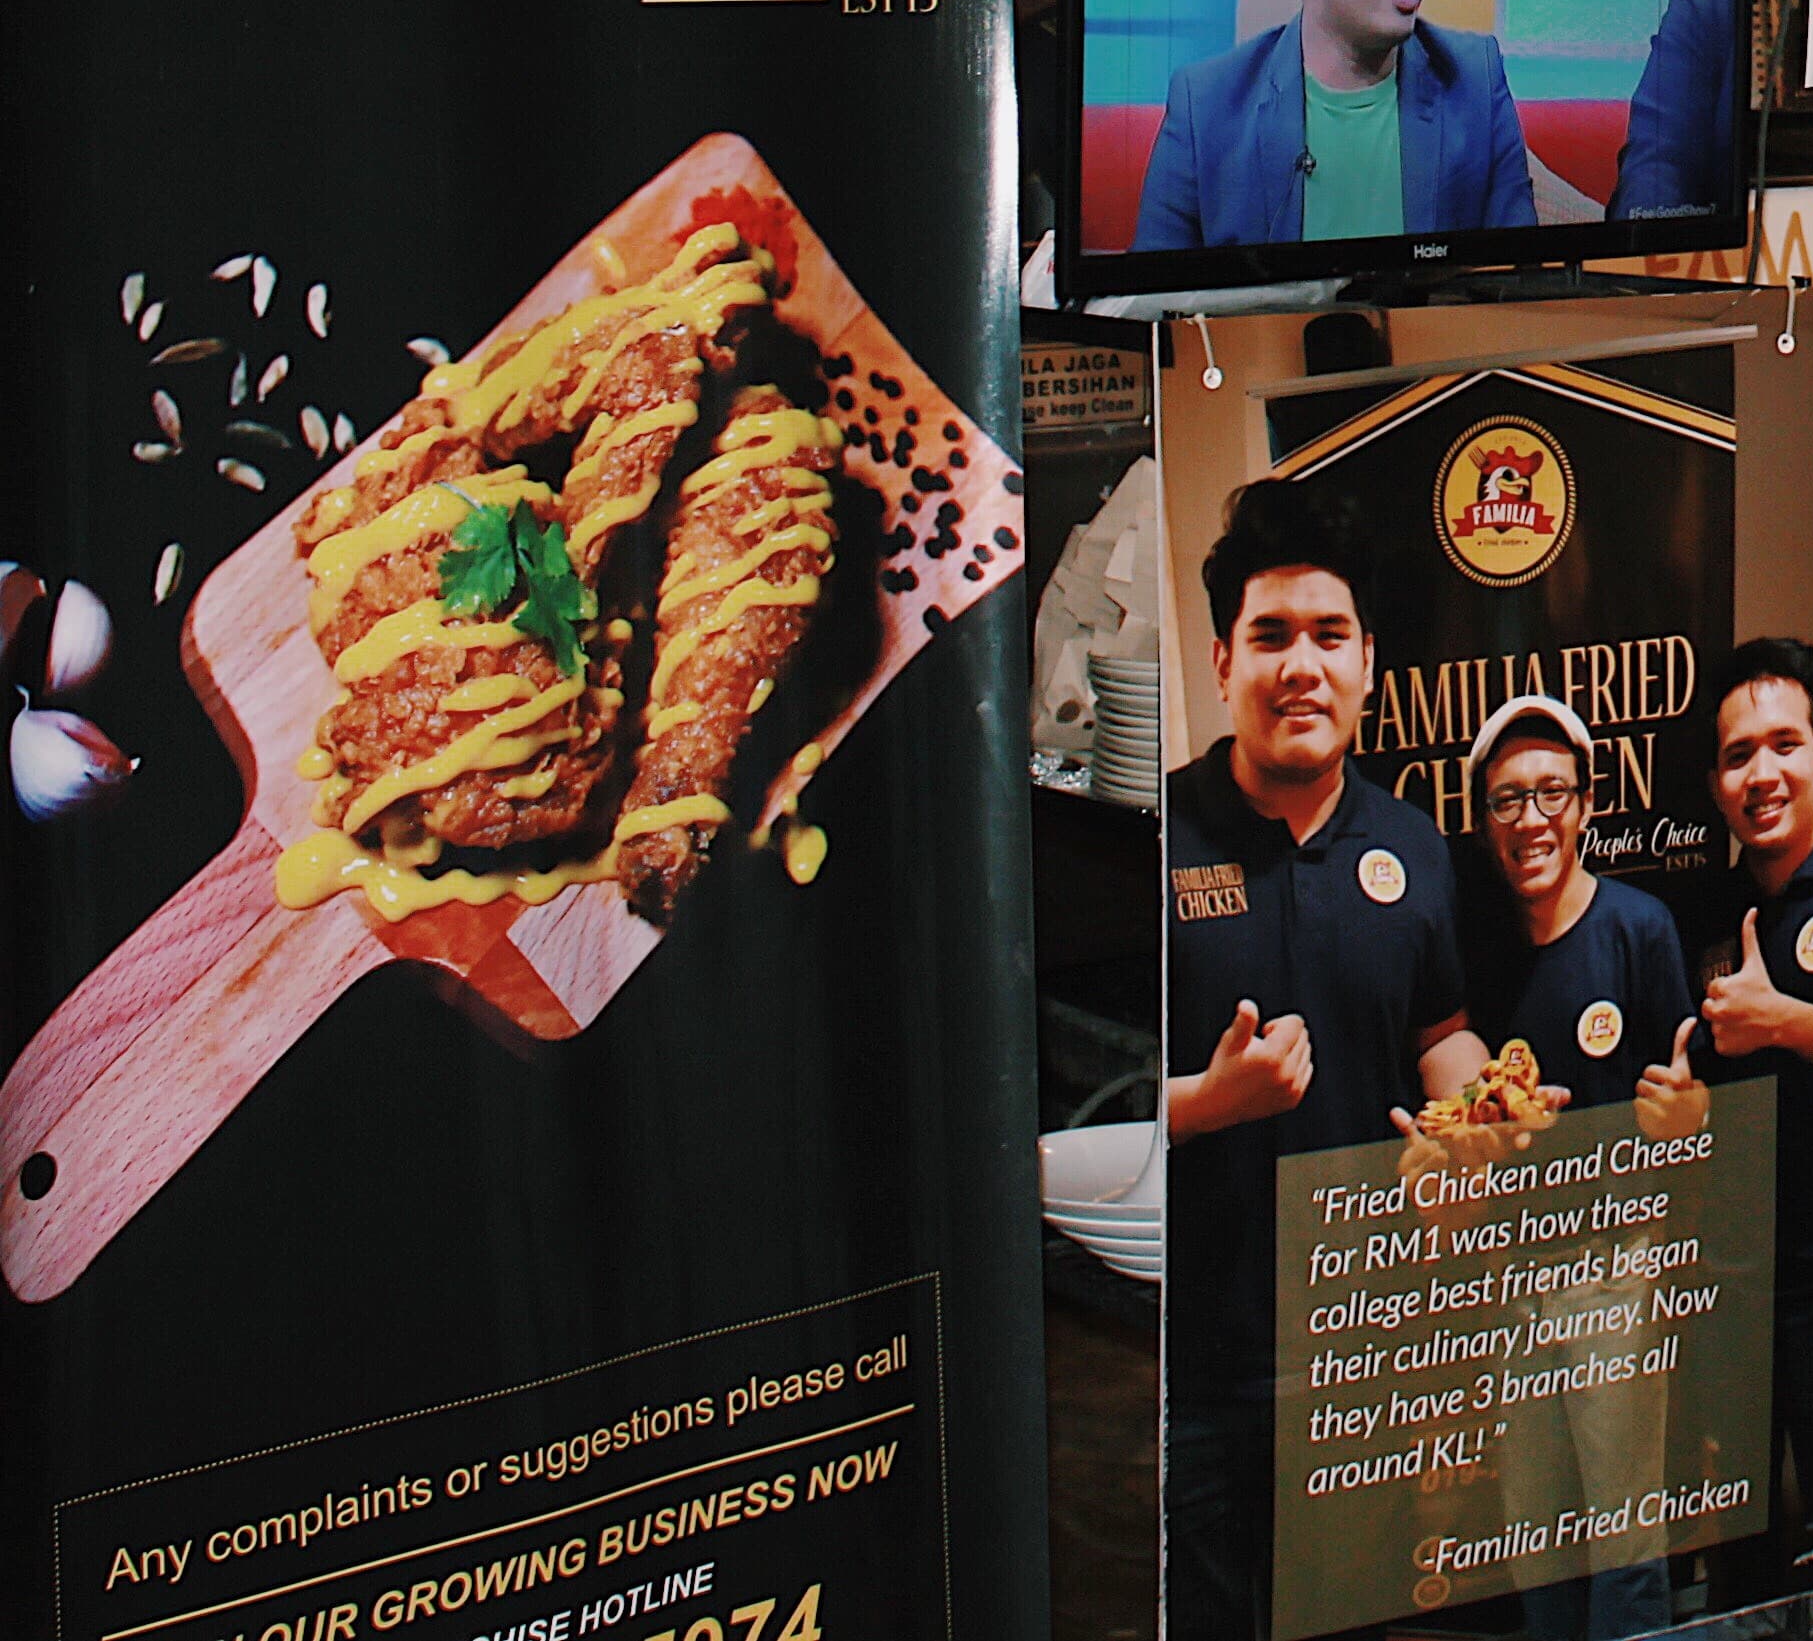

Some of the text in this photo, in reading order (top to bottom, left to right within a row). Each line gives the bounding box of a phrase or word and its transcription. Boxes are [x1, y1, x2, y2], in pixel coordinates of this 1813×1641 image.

[1414, 243, 1449, 259] Haier
[1022, 374, 1136, 399] BERSIHAN
[1063, 353, 1122, 373] JAGA
[1050, 402, 1087, 419] keep
[1090, 398, 1135, 415] Clean
[1472, 503, 1537, 527] FAMILIA
[1560, 635, 1696, 728] FRIED
[1651, 816, 1707, 857] Choice
[1171, 866, 1216, 892] FAMILIA
[1177, 886, 1249, 922] CHICKEN
[1414, 1161, 1538, 1207] Chicken
[1544, 1142, 1604, 1189] and
[1609, 1130, 1714, 1175] Cheese
[1308, 1188, 1670, 1286] for RM1 was how these
[1308, 1235, 1700, 1337] college best friends began
[1309, 1282, 1720, 1389] their culinary journey. Now
[1308, 1334, 1680, 1443] they have 3 branches all
[105, 1333, 908, 1592] Any complaints or suggestions please call
[1306, 1446, 1423, 1496] around
[370, 1536, 587, 1631] GROWING
[598, 1472, 797, 1567] BUSINESS
[806, 1440, 899, 1503] NOW
[1422, 1477, 1751, 1574] -Familia Fried Chicken
[578, 1561, 715, 1635] HOTLINE
